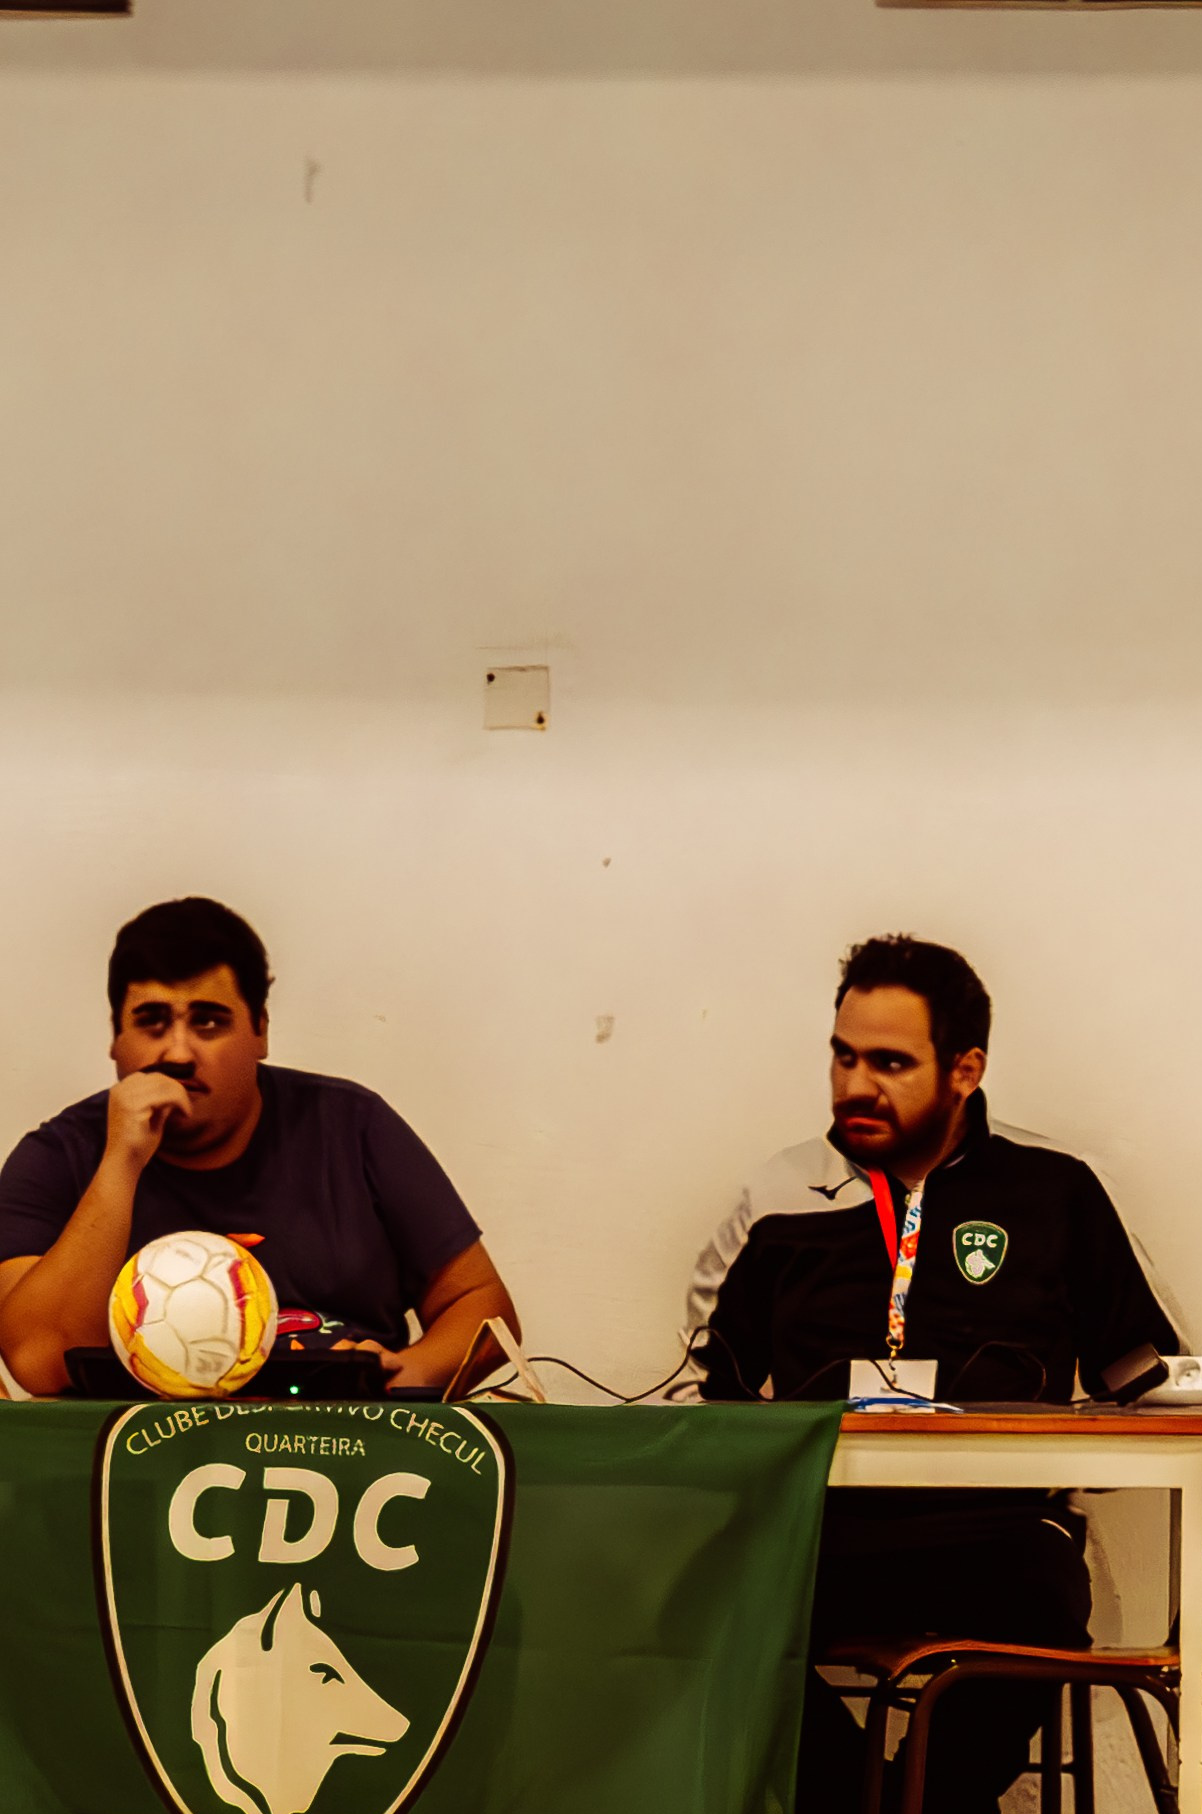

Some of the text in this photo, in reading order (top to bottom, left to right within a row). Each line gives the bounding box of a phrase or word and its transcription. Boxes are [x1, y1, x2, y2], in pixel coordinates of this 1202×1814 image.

[962, 1232, 998, 1248] CDC
[126, 1405, 209, 1455] CLUBE
[390, 1408, 490, 1476] CHECUL
[245, 1432, 366, 1457] QUARTEIRA
[168, 1463, 432, 1572] CDC
